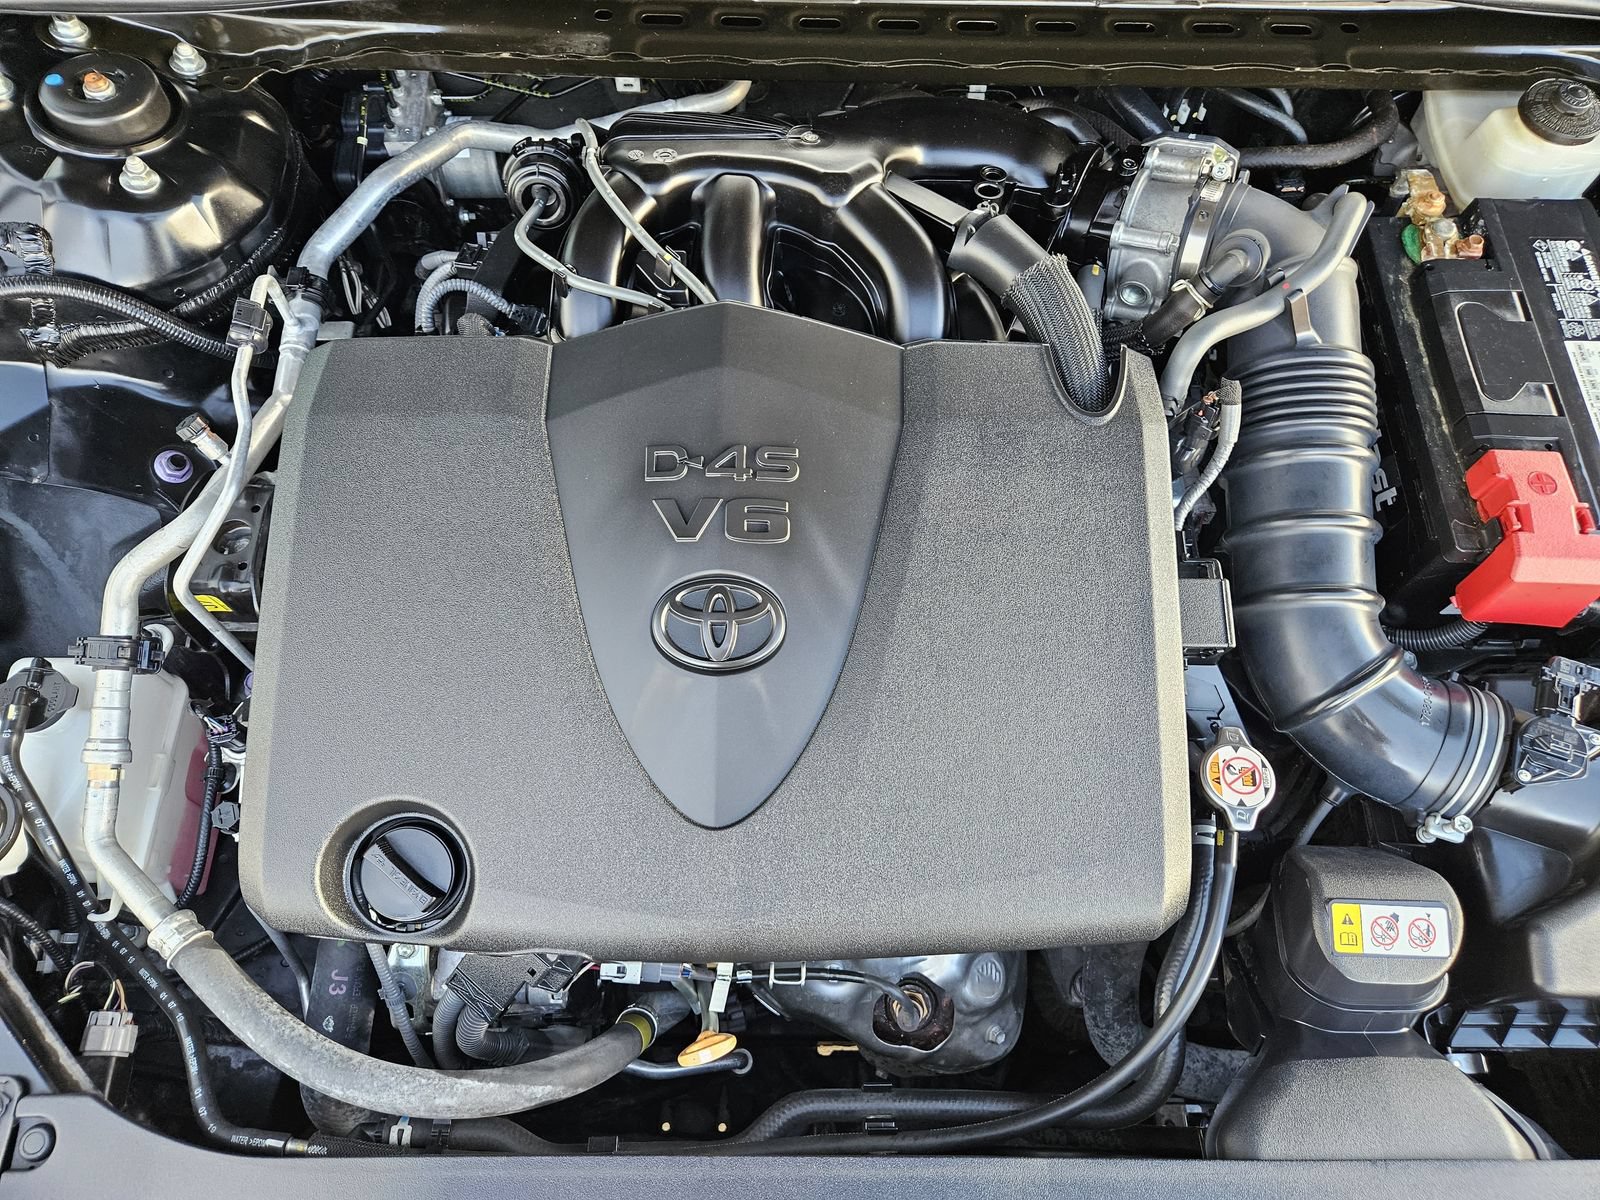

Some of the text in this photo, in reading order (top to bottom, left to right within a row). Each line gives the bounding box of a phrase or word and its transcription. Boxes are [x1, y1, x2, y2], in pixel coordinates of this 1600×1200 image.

[645, 445, 799, 482] D-4S
[652, 498, 791, 544] V6
[329, 968, 349, 996] J3
[185, 1036, 195, 1053] WATER
[194, 1087, 203, 1099] 01
[198, 1106, 208, 1118] 07
[207, 1122, 218, 1134] 19
[230, 1134, 249, 1146] WATER
